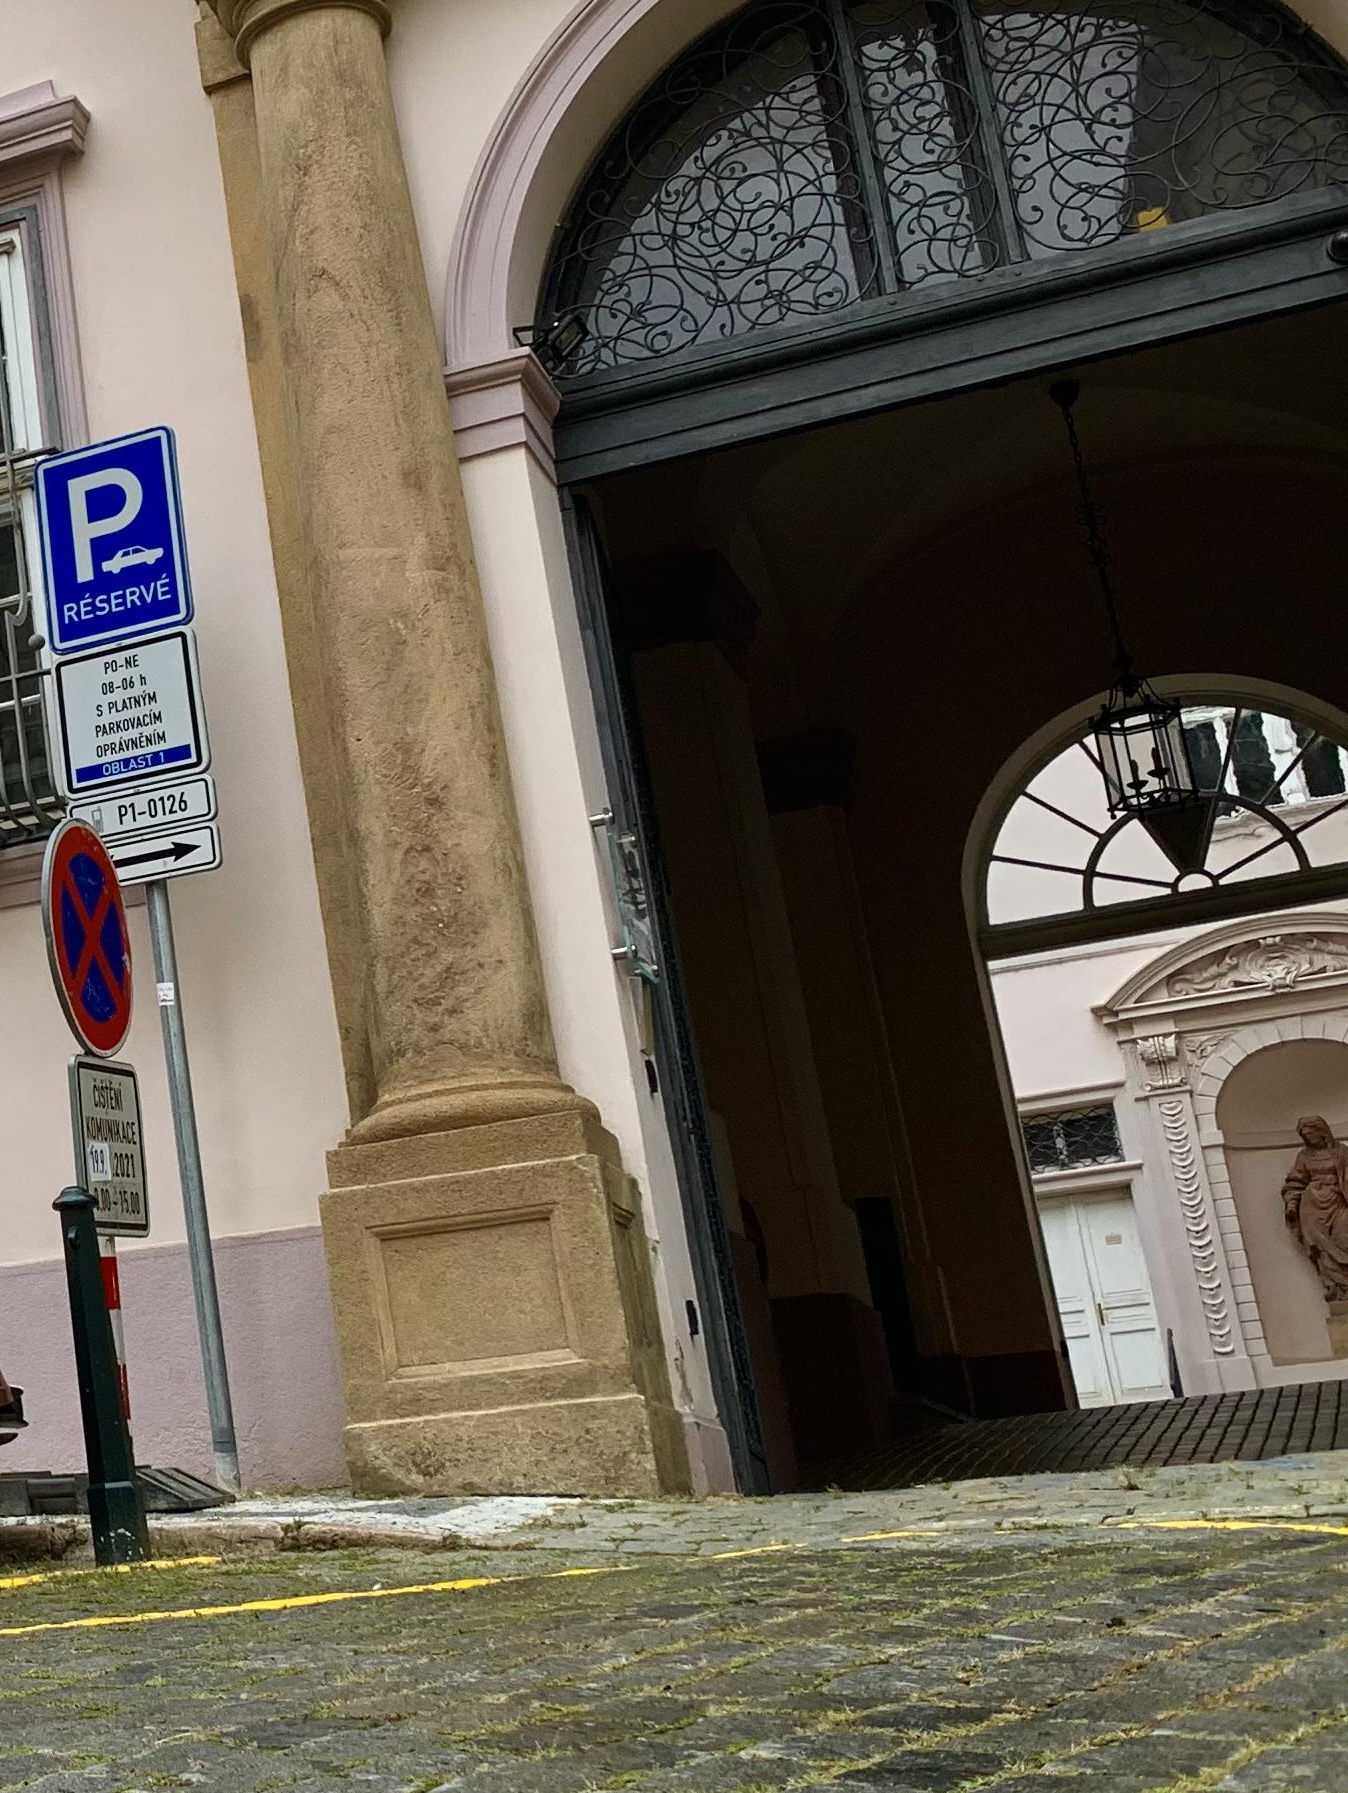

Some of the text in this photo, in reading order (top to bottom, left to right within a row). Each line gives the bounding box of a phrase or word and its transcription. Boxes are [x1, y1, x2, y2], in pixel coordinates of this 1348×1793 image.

[67, 467, 143, 583] P
[63, 574, 172, 624] RÉSERVÉ
[104, 654, 139, 674] PO-NE
[102, 674, 147, 695] 08-06 h
[96, 690, 158, 717] S PLATNÝM
[95, 709, 163, 737] PARKOVACÍM
[96, 729, 167, 758] OPRÁVNĚNÍM
[103, 752, 165, 776] OBLAST 1
[118, 792, 188, 825] P1-0126
[92, 1077, 123, 1112] ČIŠTĚNÍ
[85, 1116, 137, 1145] KOMUNIKACE
